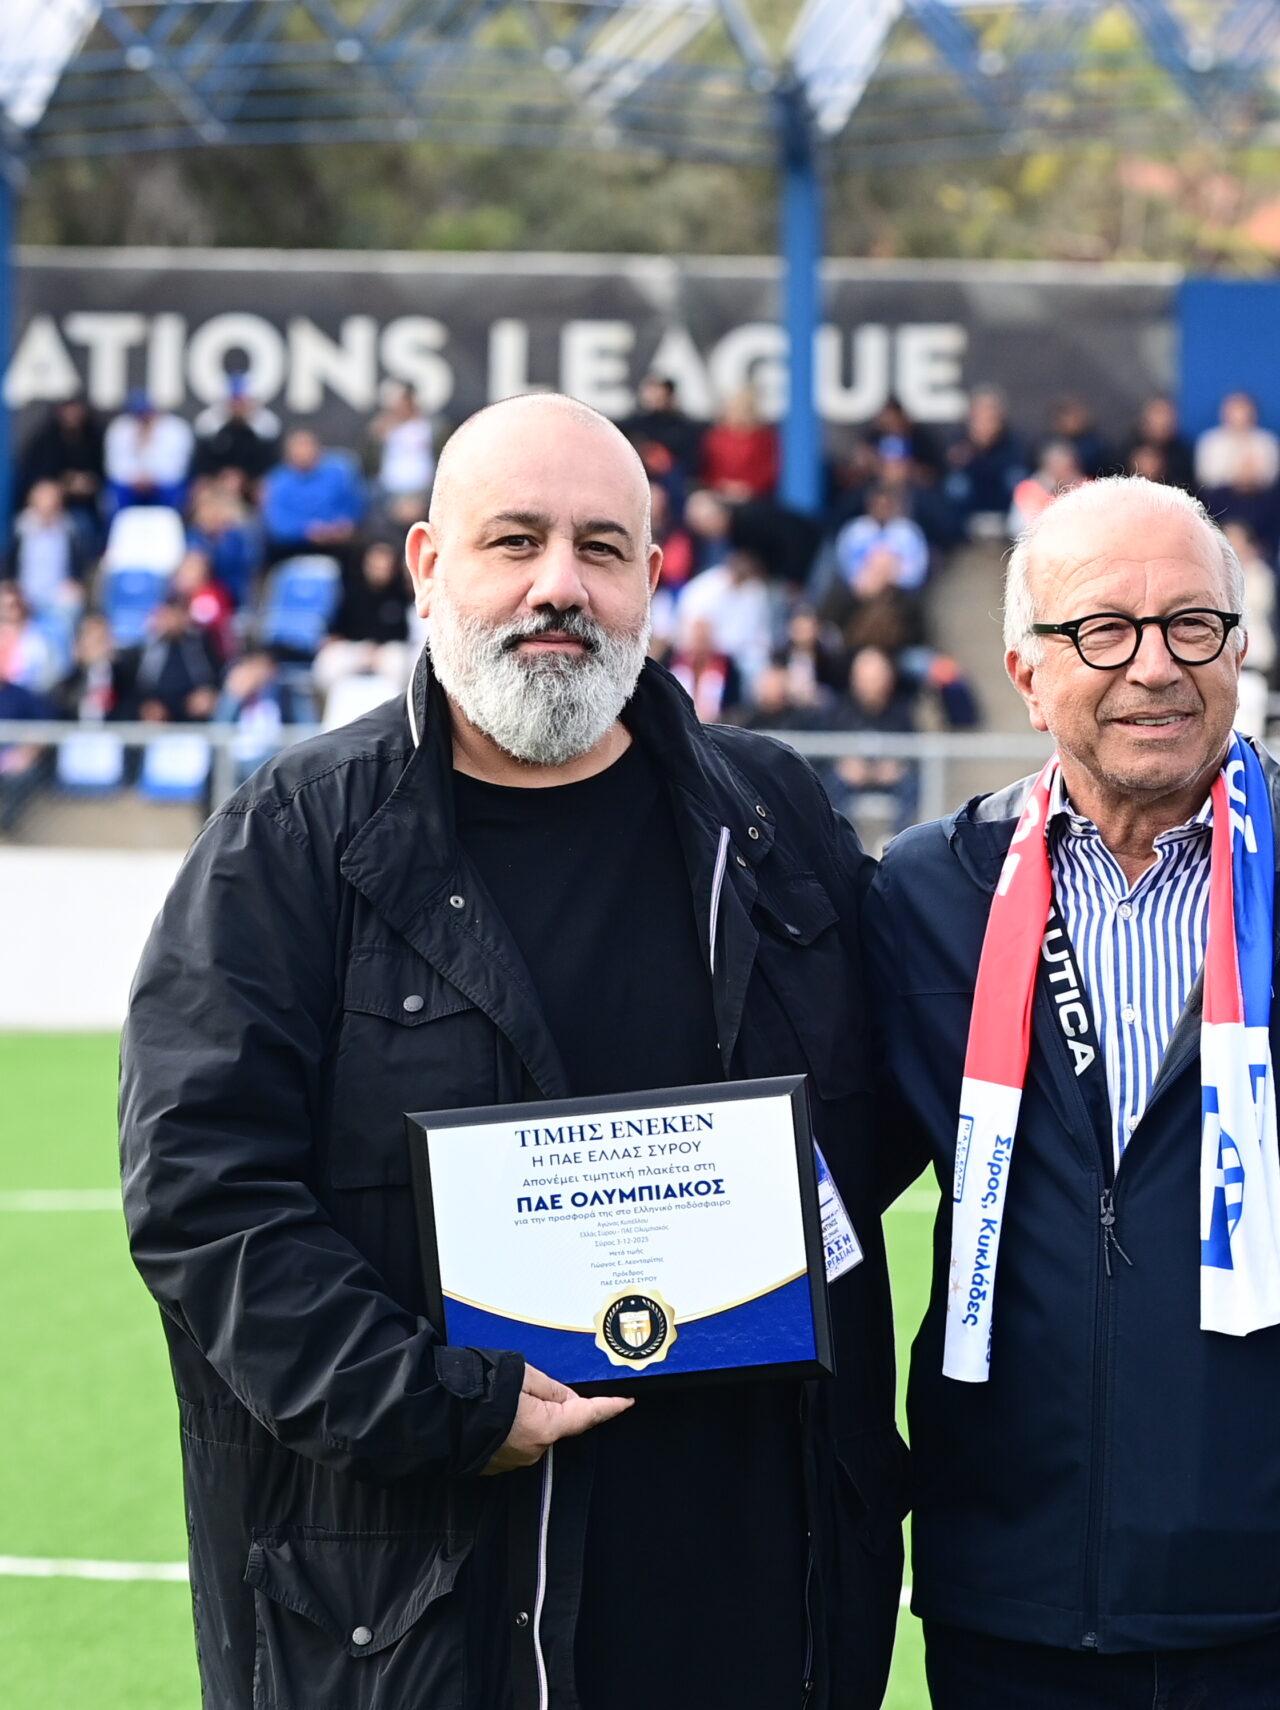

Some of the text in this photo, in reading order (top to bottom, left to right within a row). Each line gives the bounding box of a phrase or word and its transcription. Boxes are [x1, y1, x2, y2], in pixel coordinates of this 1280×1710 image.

[488, 318, 970, 423] LEAGUE
[1041, 905, 1096, 1077] UTICA
[515, 1113, 714, 1148] ΤΙΜΗΣ ΕΝΕΚΕΝ
[532, 1141, 701, 1167] Η ΠΑΕ ΕΛΛΑΣ ΣΥΡΟΥ
[522, 1161, 716, 1187] Απονέμει τιμητική πλακέτα στη
[514, 1197, 731, 1226] για την προσφορά της στο Ελληνικό ποδόσφαιρο
[517, 1179, 725, 1213] ΠΑΕ ΟΛΥΜΠΙΑΚΟΣ
[826, 1233, 852, 1258] ΑΣΗ
[962, 1134, 1012, 1326] Σύρος, Κυκλάδες
